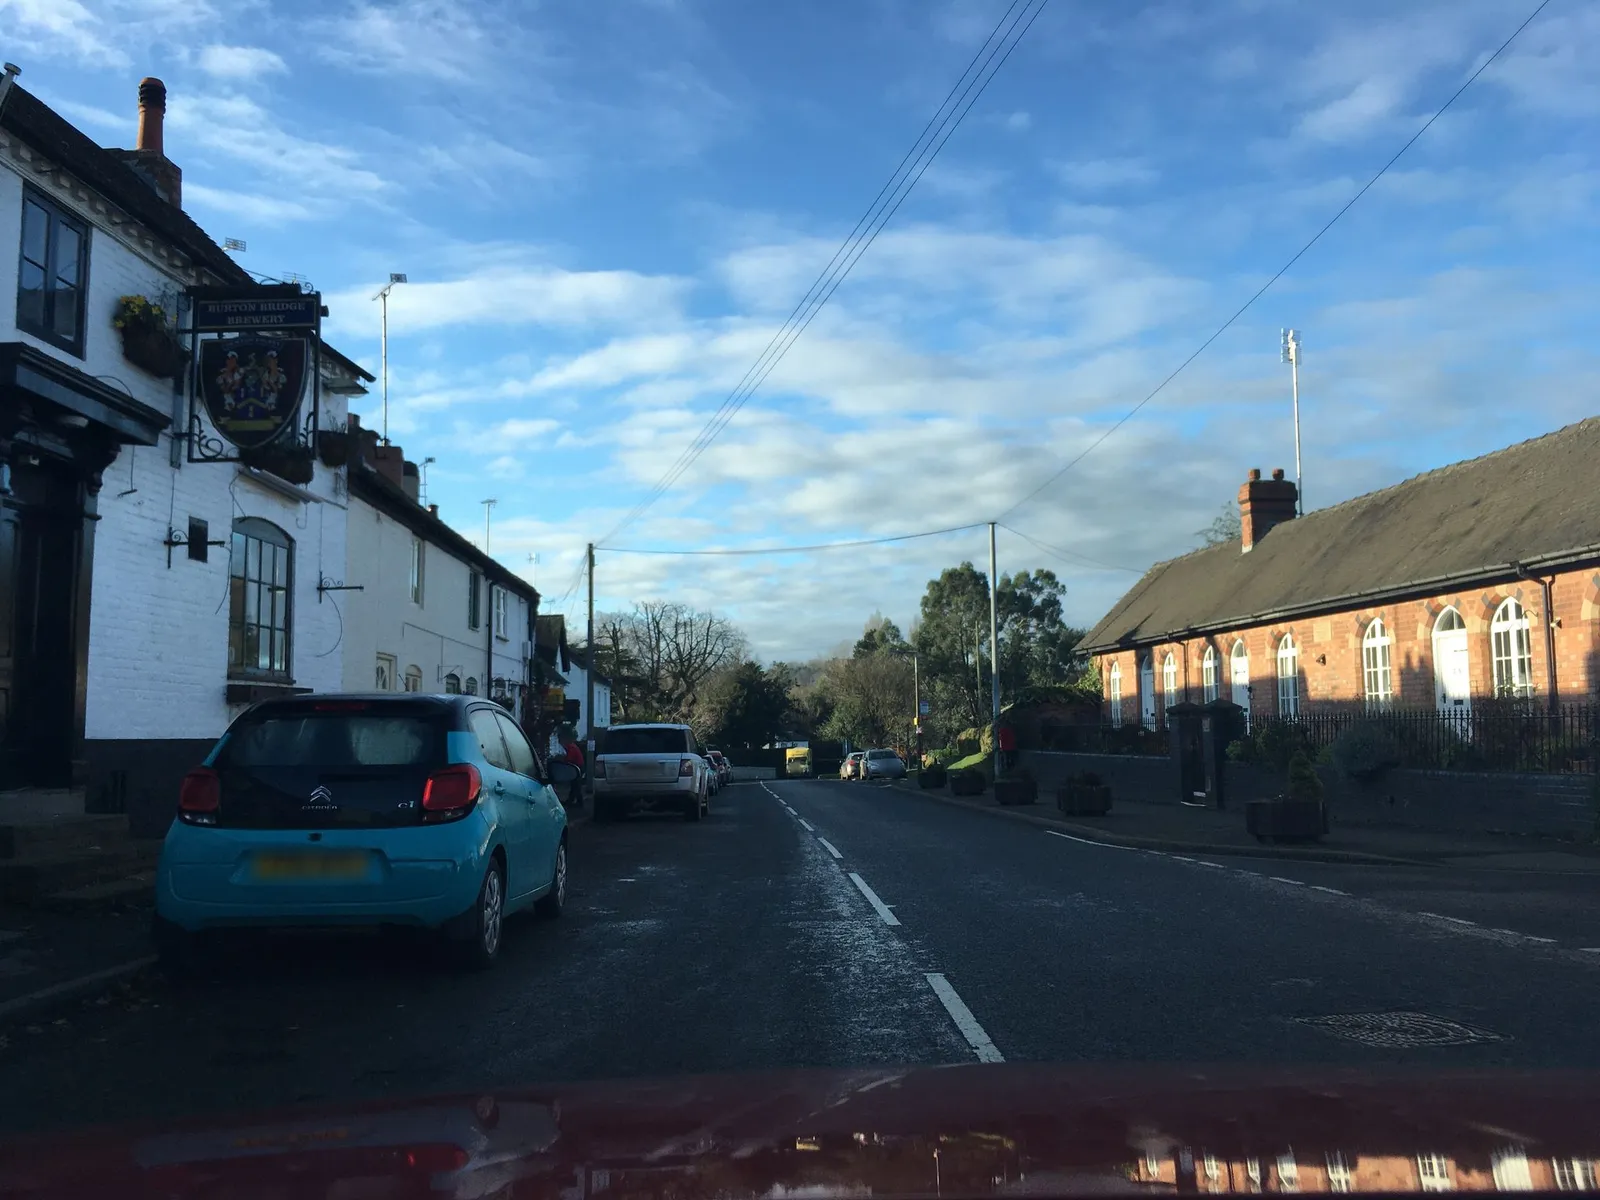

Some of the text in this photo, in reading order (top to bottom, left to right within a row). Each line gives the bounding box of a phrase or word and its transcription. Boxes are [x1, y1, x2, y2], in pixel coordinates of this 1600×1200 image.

[207, 301, 306, 313] BURTON BRIDGE
[227, 315, 286, 325] BREWERY
